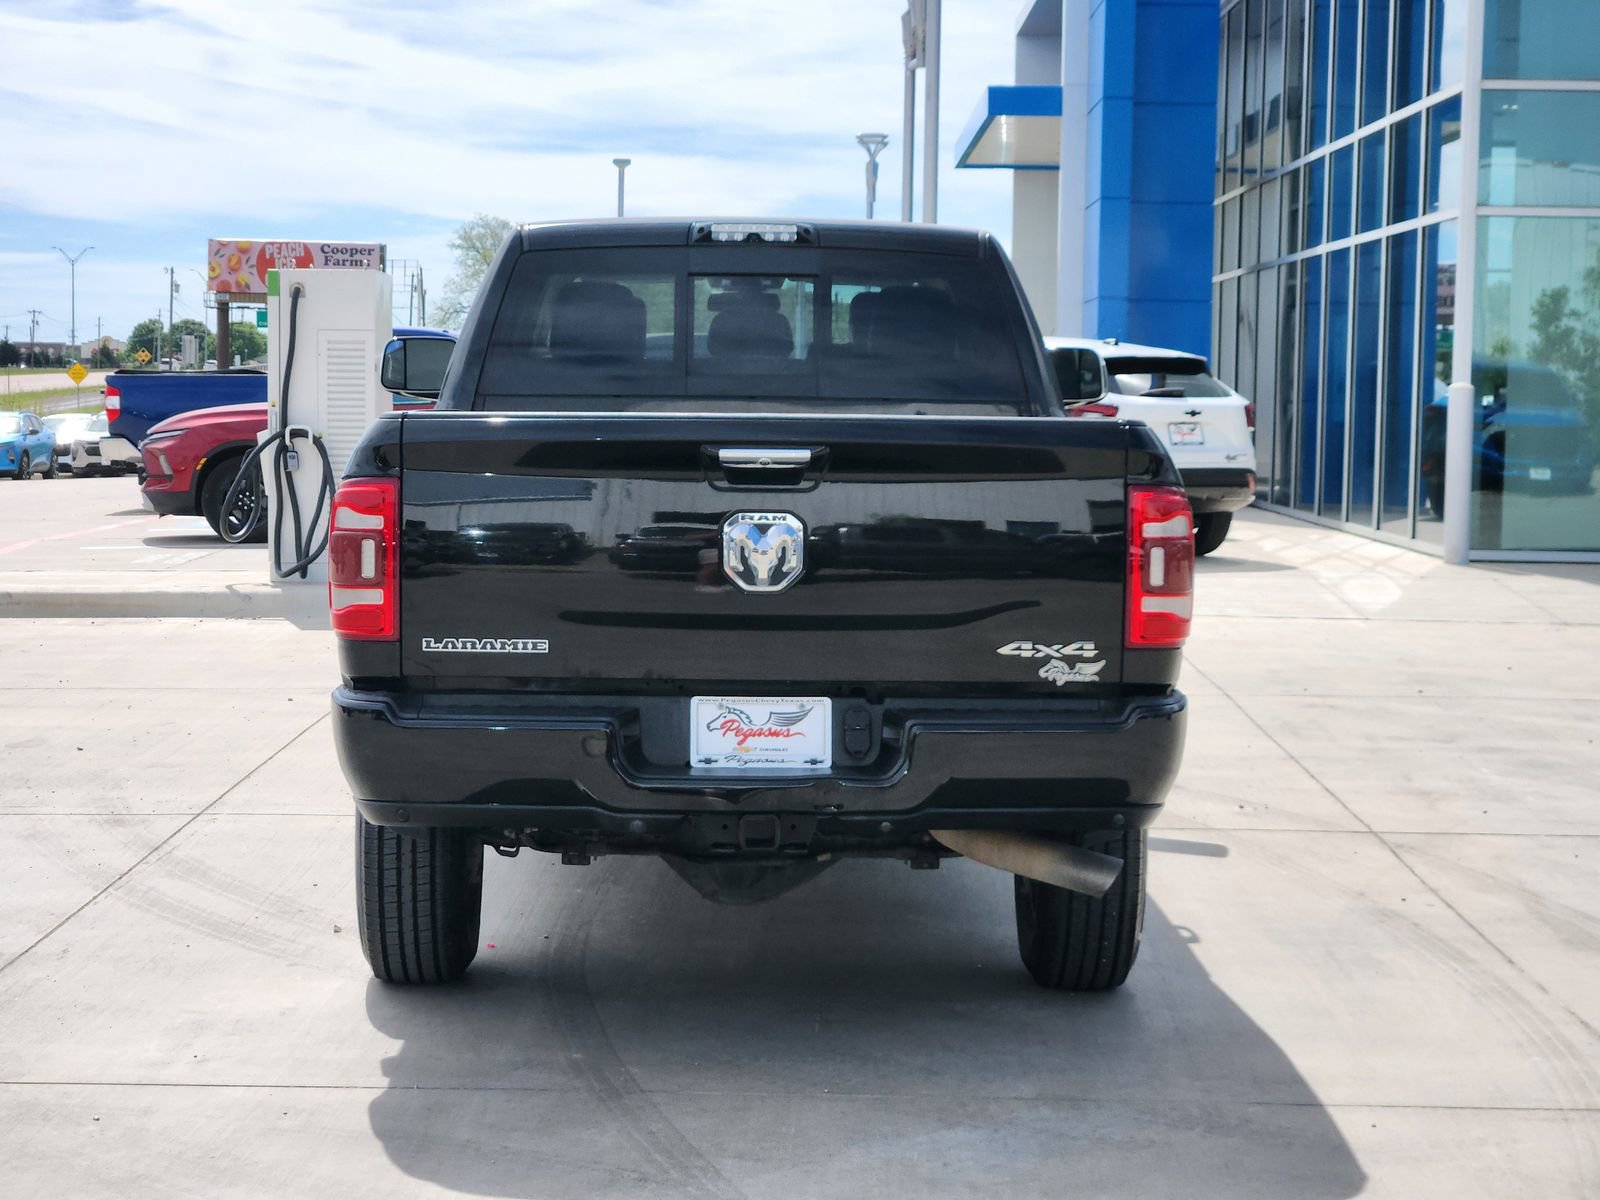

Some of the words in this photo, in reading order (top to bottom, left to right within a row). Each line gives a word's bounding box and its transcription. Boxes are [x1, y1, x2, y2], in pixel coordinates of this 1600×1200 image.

[265, 242, 305, 259] PEACH
[320, 243, 375, 257] Cooper
[422, 638, 549, 653] LARAMIE
[720, 719, 806, 746] Pegasus
